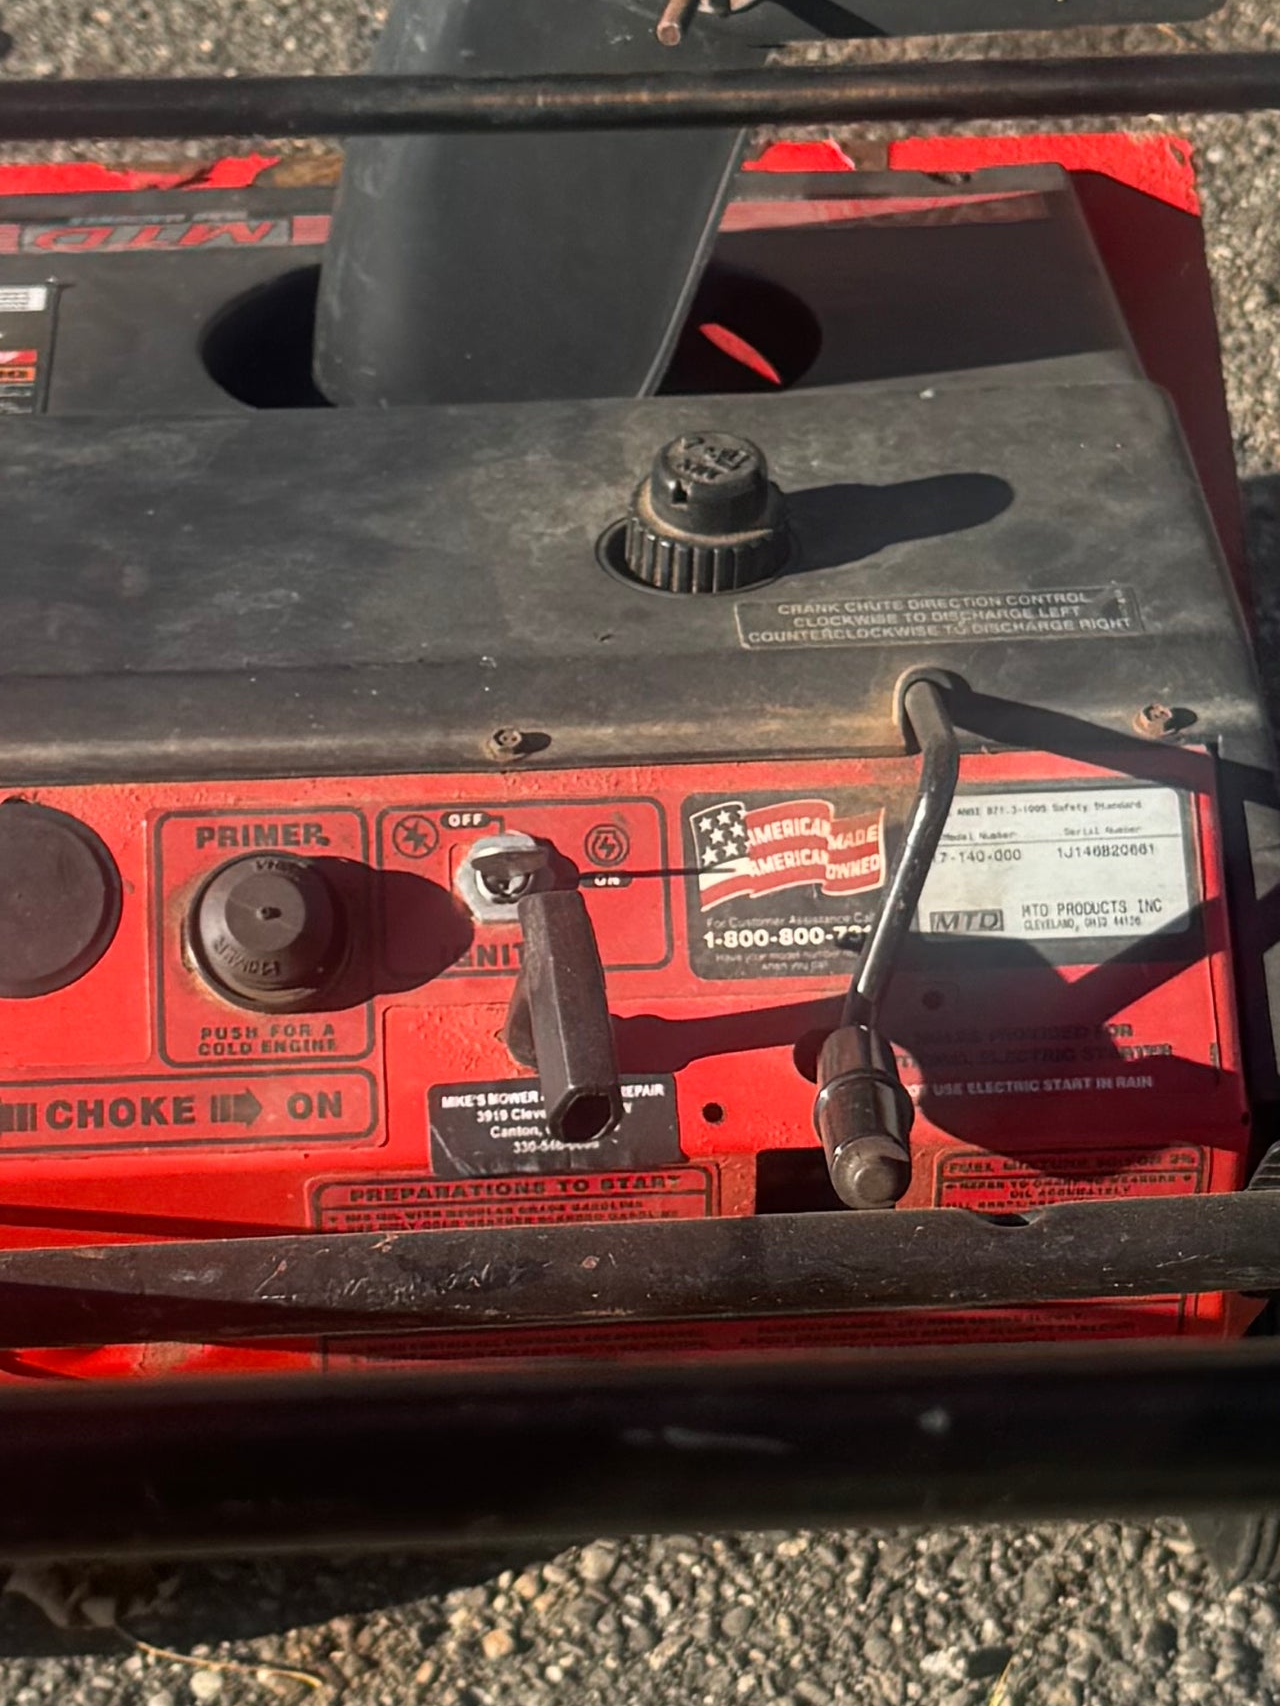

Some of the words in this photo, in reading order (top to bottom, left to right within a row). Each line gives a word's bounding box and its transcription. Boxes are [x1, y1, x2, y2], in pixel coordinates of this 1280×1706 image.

[777, 603, 840, 616] CRANK
[907, 596, 1002, 610] DIRECTION
[1006, 592, 1089, 606] CONTROL
[793, 615, 900, 629] CLOCKWISE
[904, 612, 927, 624] TO
[930, 607, 1035, 622] DISCHARGE
[1038, 605, 1081, 618] LEFT
[748, 627, 938, 644] COUNTERCLOCKWISE
[943, 625, 968, 638] TO
[971, 620, 1075, 636] DISCHARGE
[1080, 616, 1132, 630] RIGHT
[448, 813, 484, 827] OFF
[196, 822, 328, 848] PRIMER
[827, 824, 880, 850] MADE
[825, 854, 881, 879] OWNED
[1022, 904, 1048, 918] MTD
[1057, 900, 1128, 916] PRODUCTS
[1138, 898, 1163, 913] INC
[933, 912, 1000, 932] MTD
[200, 1026, 259, 1040] PUSH
[271, 1023, 312, 1037] FOR
[323, 1023, 335, 1036] A
[198, 1041, 252, 1056] COLD
[261, 1039, 337, 1054] ENGINE
[932, 1081, 963, 1096] USE
[966, 1078, 1040, 1094] ELECTRIC
[1042, 1077, 1093, 1091] START
[1096, 1076, 1113, 1090] IN
[1115, 1075, 1154, 1089] RAIN
[45, 1095, 196, 1129] CHOKE
[286, 1091, 343, 1119] ON
[441, 1094, 486, 1108] MIKE'S
[488, 1090, 538, 1105] MOWER
[490, 1126, 542, 1139] Canton,
[350, 1181, 545, 1202] PREPARATIONS
[557, 1178, 590, 1193] TO
[600, 1175, 681, 1190] START
